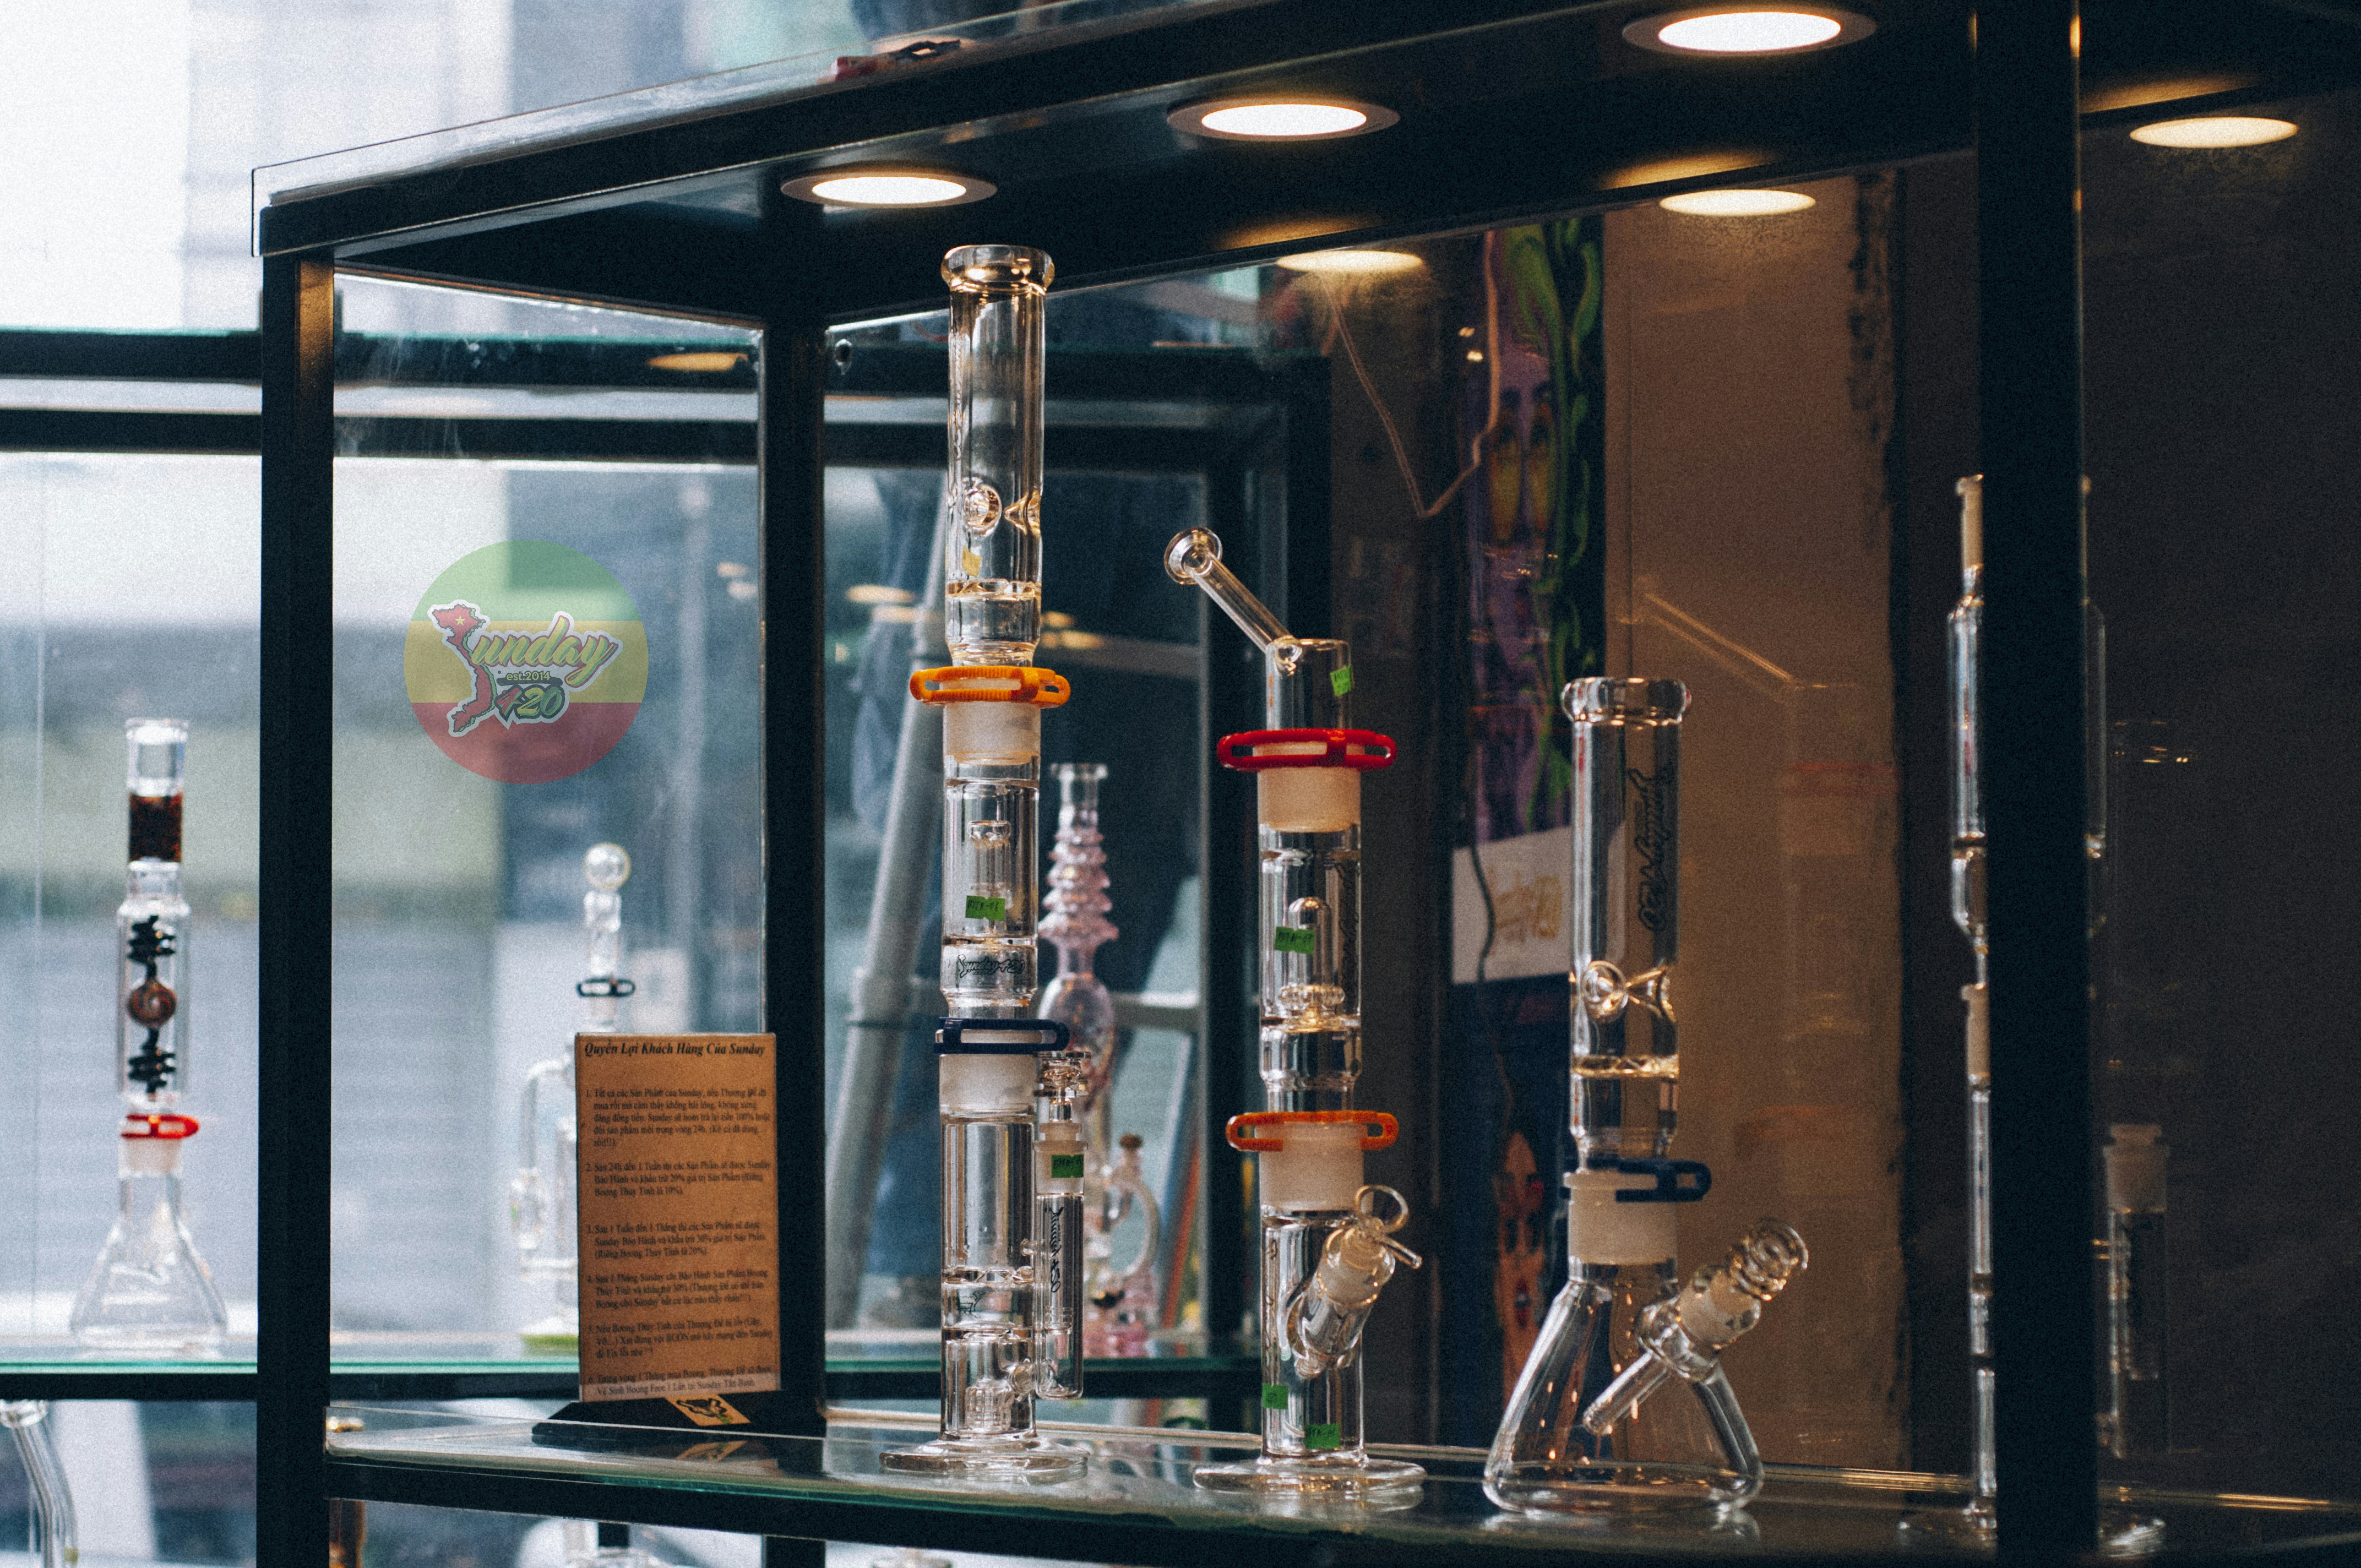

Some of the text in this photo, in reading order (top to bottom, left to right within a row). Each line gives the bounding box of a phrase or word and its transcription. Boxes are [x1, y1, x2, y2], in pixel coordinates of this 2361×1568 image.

[585, 1040, 618, 1057] Quyền
[641, 1042, 673, 1054] Khách
[676, 1042, 703, 1057] Hàng
[707, 1042, 726, 1054] Của
[729, 1043, 765, 1057] Sunday
